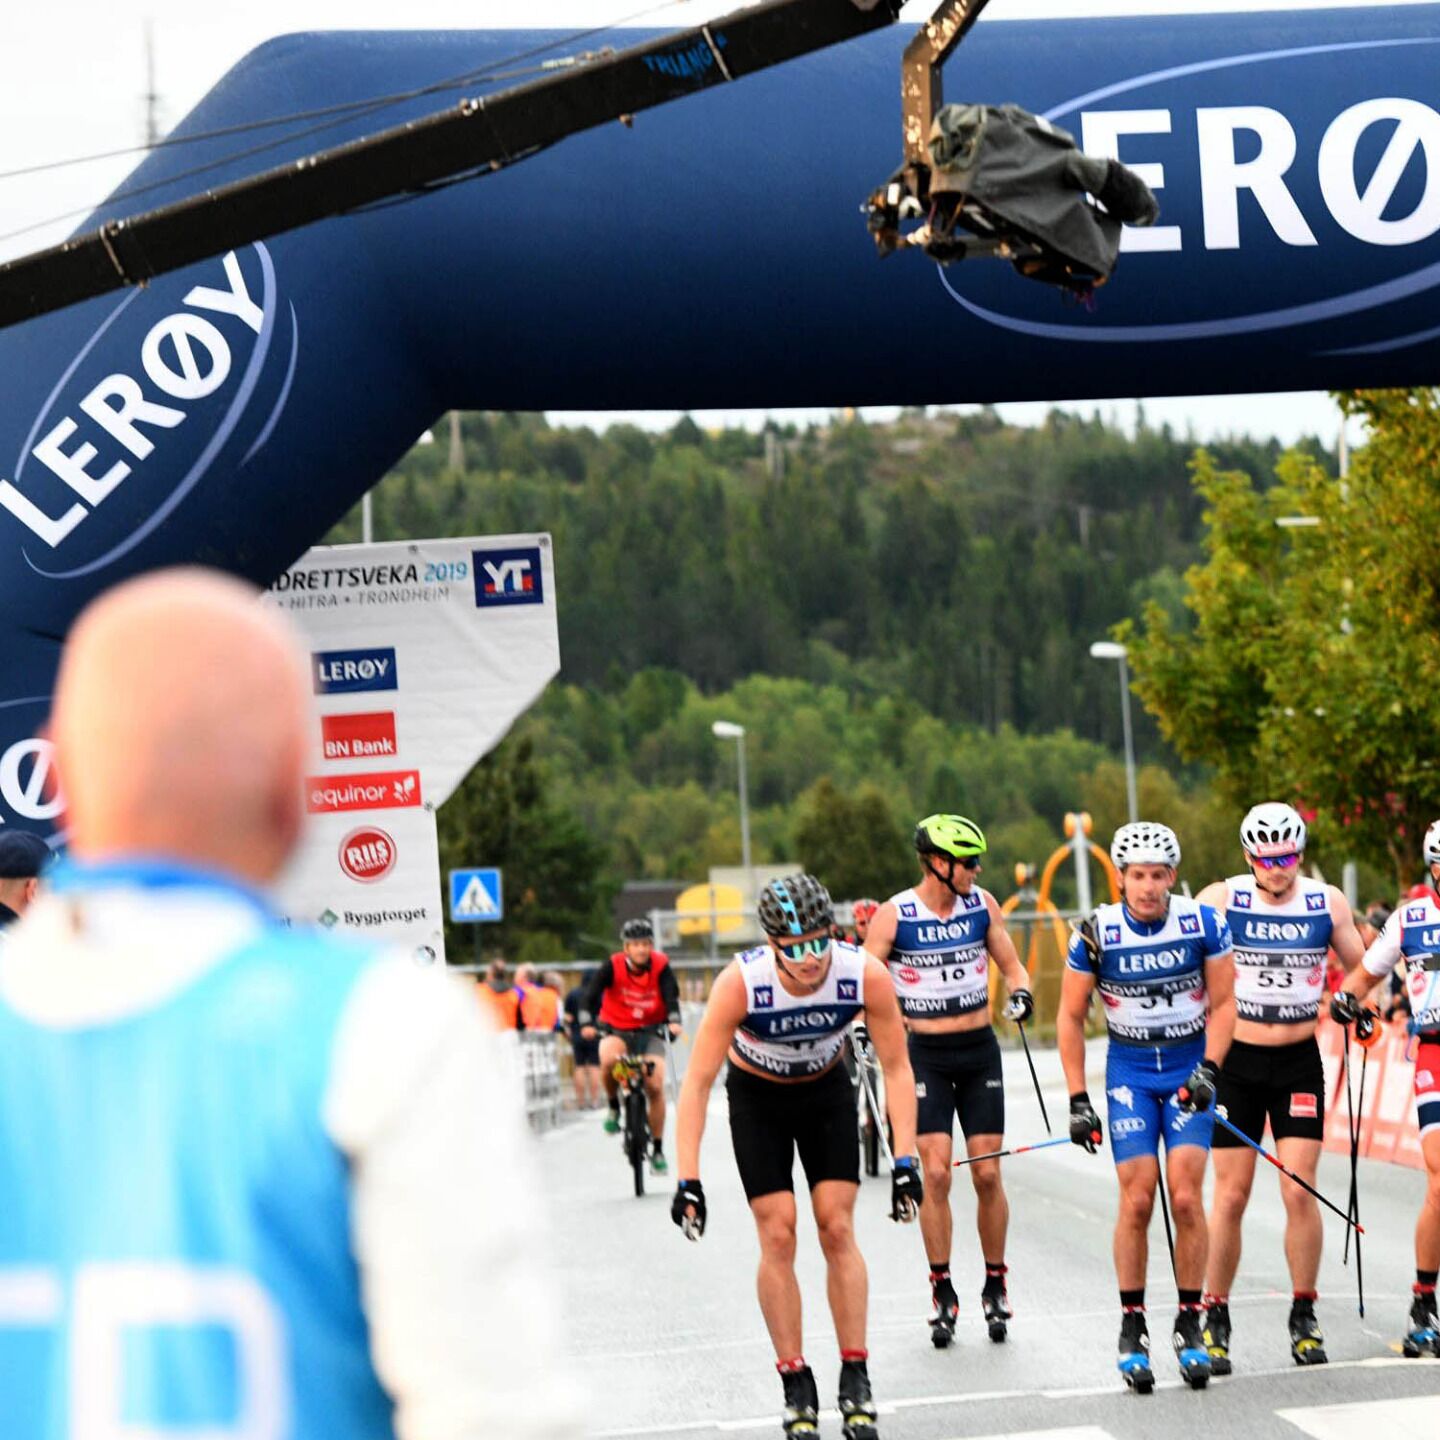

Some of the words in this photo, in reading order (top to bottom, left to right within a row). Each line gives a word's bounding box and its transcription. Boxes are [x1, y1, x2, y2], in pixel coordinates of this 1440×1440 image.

[642, 32, 728, 78] TRIANGE
[0, 250, 265, 548] LERØY
[423, 562, 468, 582] 2019
[482, 559, 531, 592] YT
[359, 587, 449, 605] TRONDHEIM
[318, 658, 389, 681] LERØY
[325, 740, 350, 757] BN
[353, 738, 394, 755] Bank
[311, 780, 388, 807] equinor
[344, 907, 427, 927] Byggtorget
[1257, 970, 1293, 988] 53
